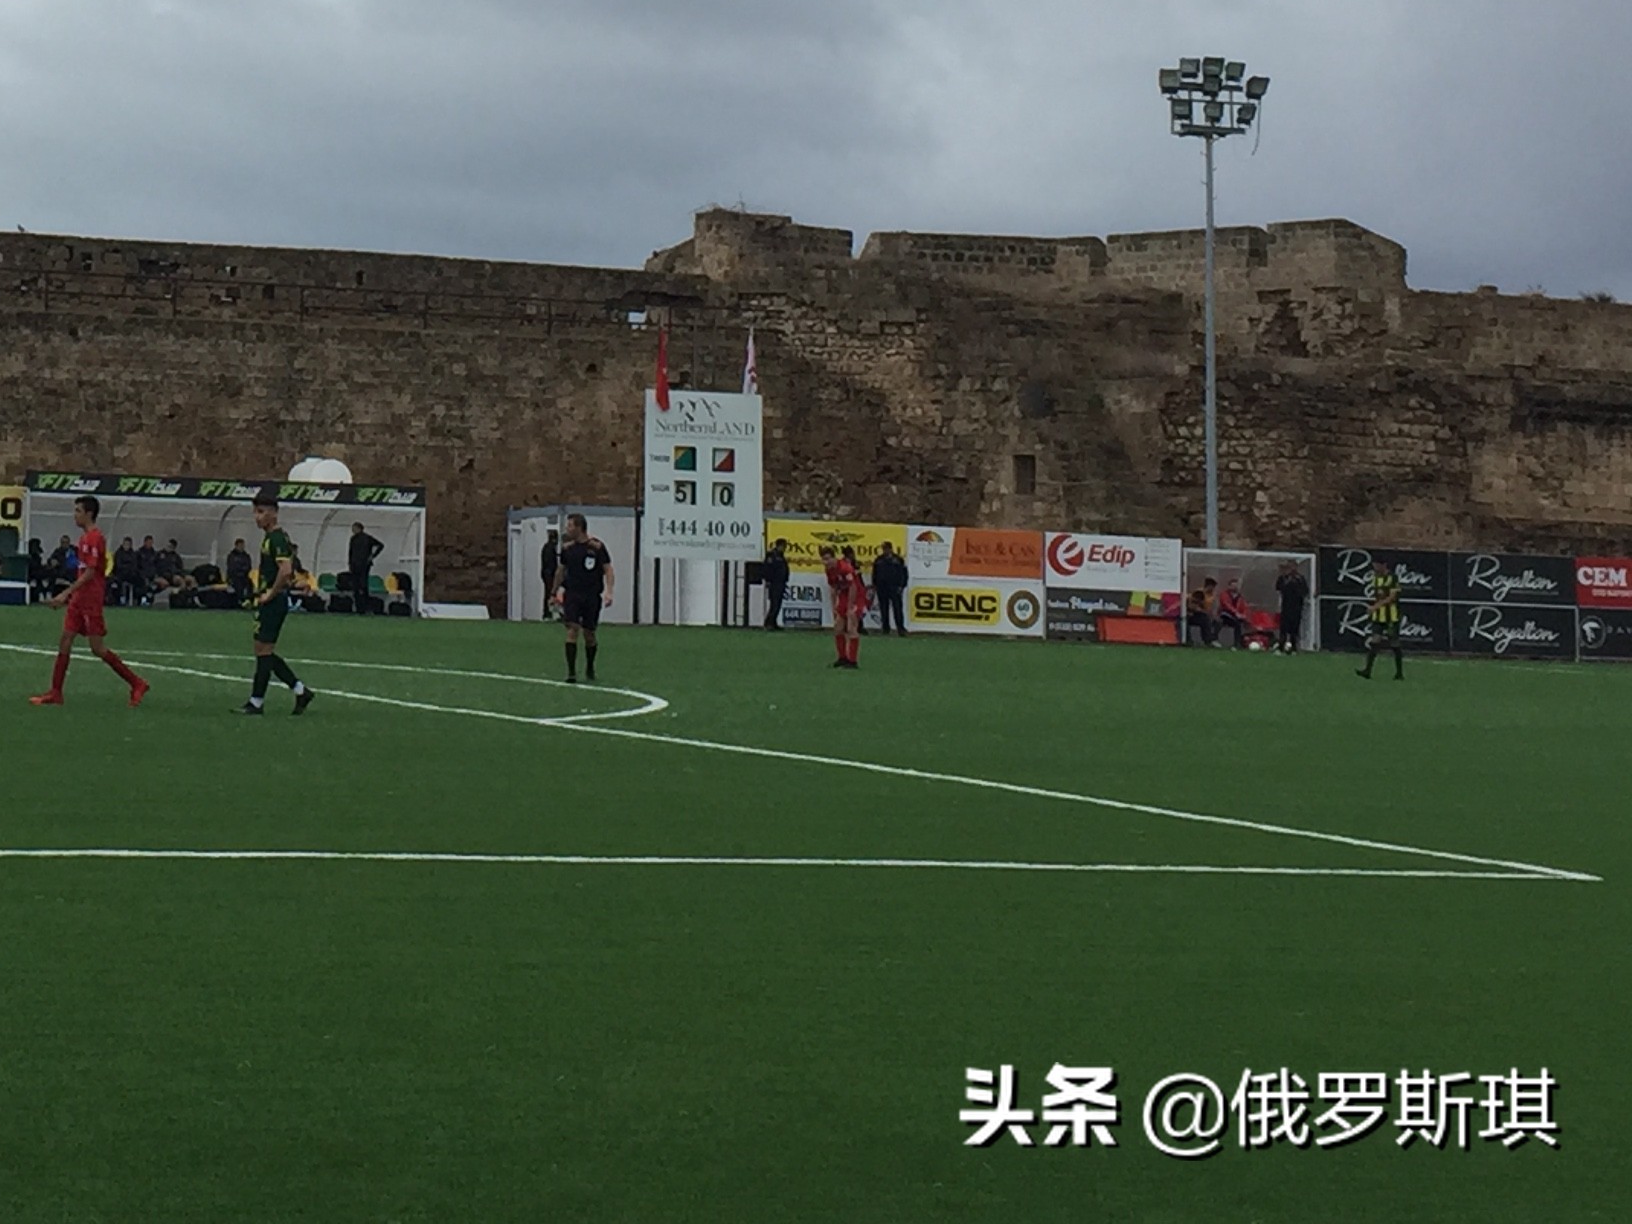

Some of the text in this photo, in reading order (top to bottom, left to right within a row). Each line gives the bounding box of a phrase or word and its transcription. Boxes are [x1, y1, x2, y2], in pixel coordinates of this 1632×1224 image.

[704, 520, 725, 537] 40
[730, 521, 751, 538] 00
[1087, 544, 1136, 568] Edip
[1465, 554, 1558, 602] Royalton
[1576, 565, 1628, 587] CEM
[1467, 605, 1560, 654] Royalton
